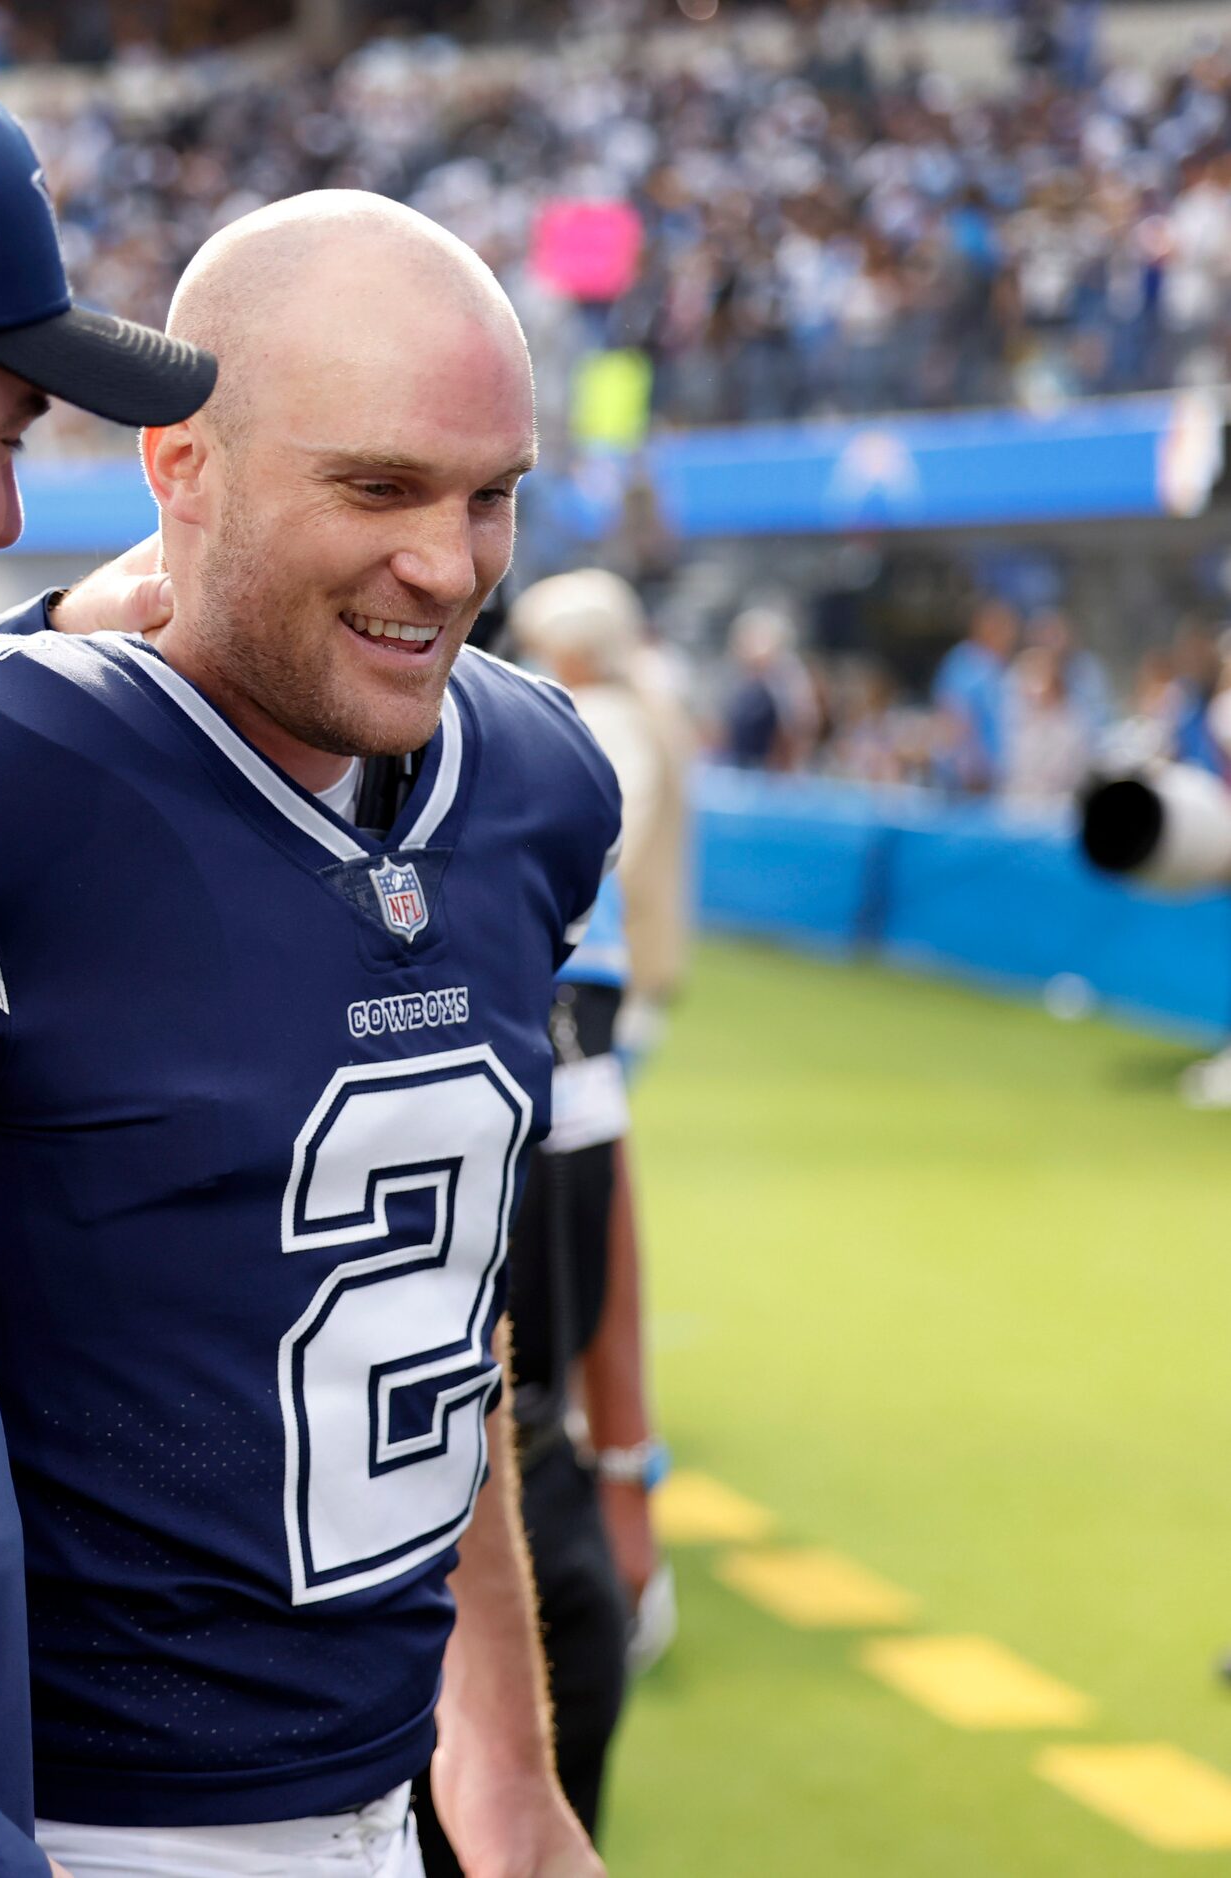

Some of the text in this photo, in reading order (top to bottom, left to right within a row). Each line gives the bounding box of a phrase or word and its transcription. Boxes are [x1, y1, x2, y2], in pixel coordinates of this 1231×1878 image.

[388, 893, 422, 926] NFL
[347, 986, 469, 1038] COWBOYS
[277, 1043, 533, 1605] 2
